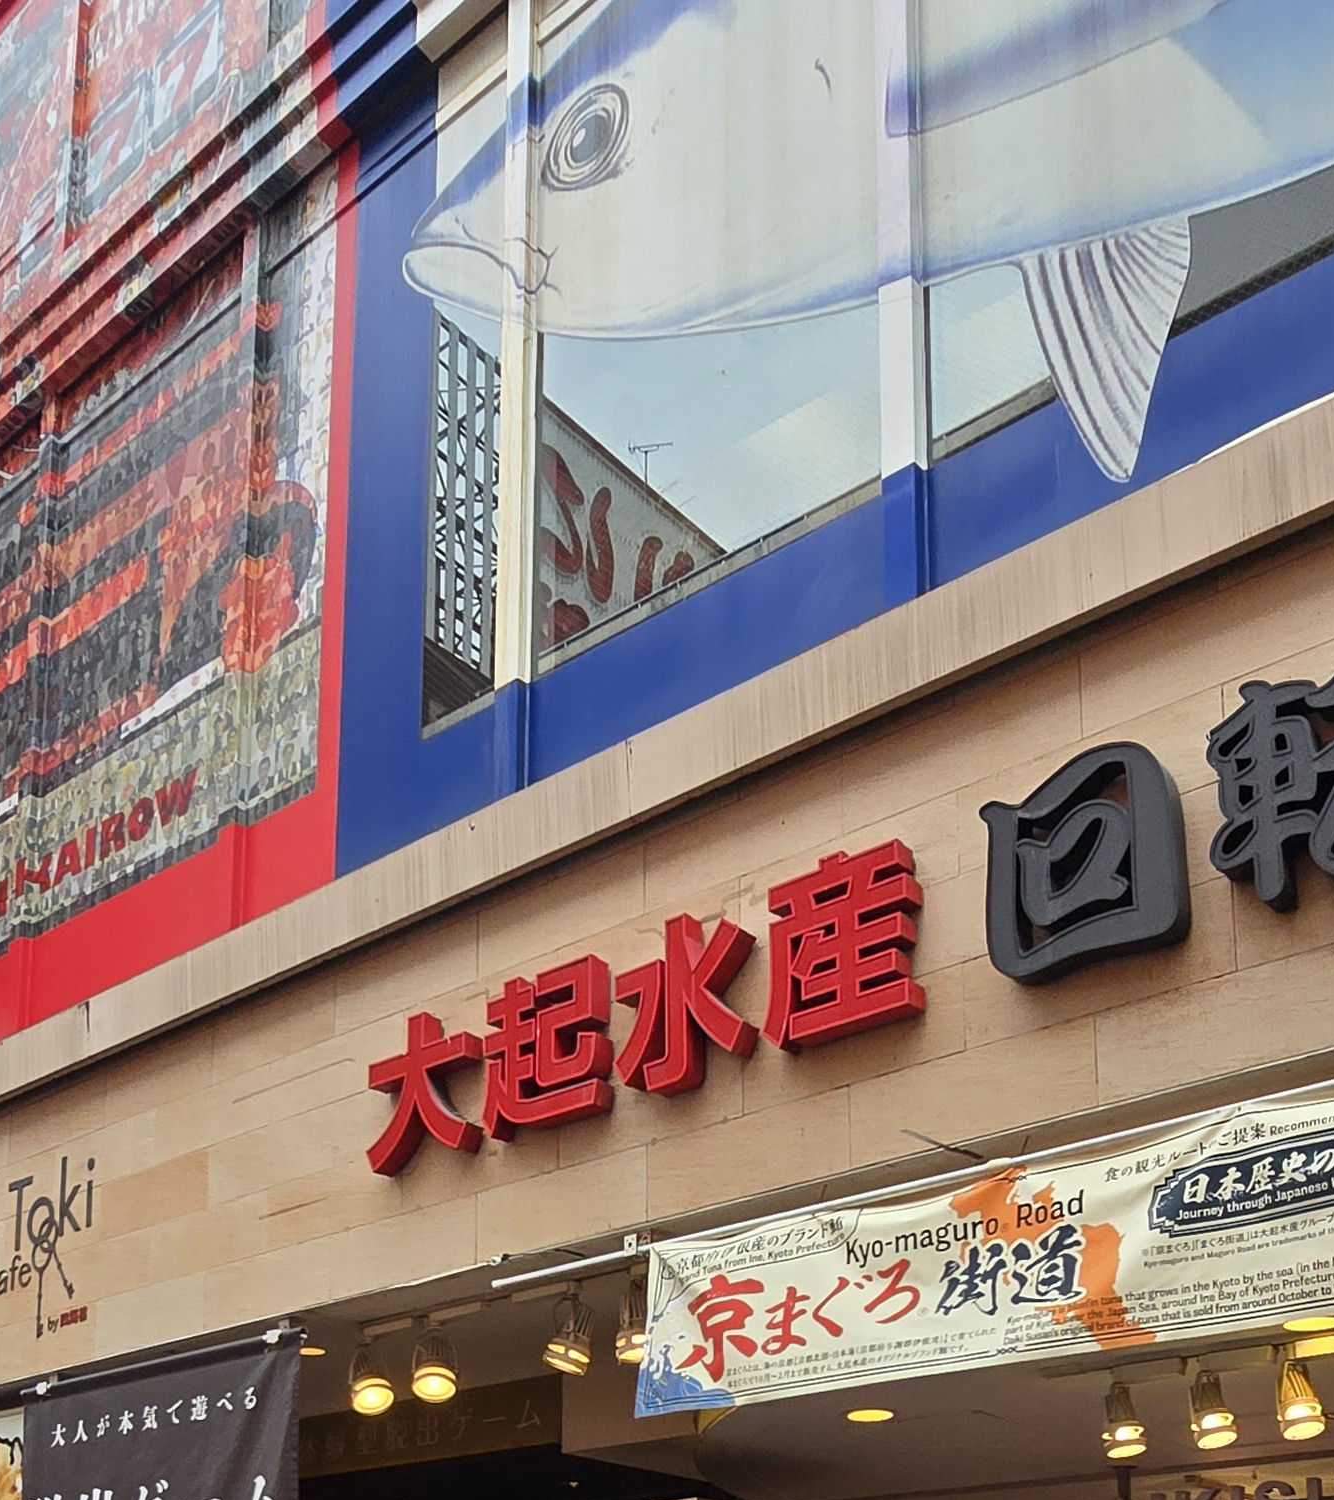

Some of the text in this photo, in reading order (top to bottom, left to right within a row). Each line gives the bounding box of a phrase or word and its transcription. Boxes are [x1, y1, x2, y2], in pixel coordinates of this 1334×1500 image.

[366, 838, 927, 1177] 大起水産
[8, 1156, 95, 1252] Toki
[1176, 1200, 1224, 1222] Journey
[1227, 1190, 1273, 1213] through
[1275, 1180, 1328, 1206] Japanese
[846, 1190, 1085, 1267] Kyo-maguro Road
[703, 1263, 724, 1276] Tuna
[725, 1258, 747, 1271] from
[768, 1249, 794, 1262] Kyoto
[1125, 1290, 1146, 1302] that
[1149, 1287, 1179, 1301] grows
[1193, 1281, 1210, 1292] the
[1213, 1276, 1240, 1291] Kyoto
[1243, 1273, 1255, 1287] by
[1257, 1270, 1273, 1282] the
[1276, 1267, 1293, 1277] sea
[1313, 1259, 1329, 1271] the
[676, 1227, 1086, 1383] 京まぐろ 街道
[1096, 1319, 1124, 1332] brand
[1138, 1314, 1160, 1325] tuna
[1161, 1310, 1181, 1322] that
[1193, 1302, 1214, 1316] sold
[1216, 1300, 1240, 1314] from
[1242, 1295, 1277, 1309] around
[1278, 1289, 1318, 1304] October
[1321, 1285, 1332, 1296] to
[1162, 1296, 1197, 1309] around
[1218, 1288, 1237, 1301] Bay
[1252, 1282, 1280, 1296] Kyoto
[47, 1316, 58, 1333] by
